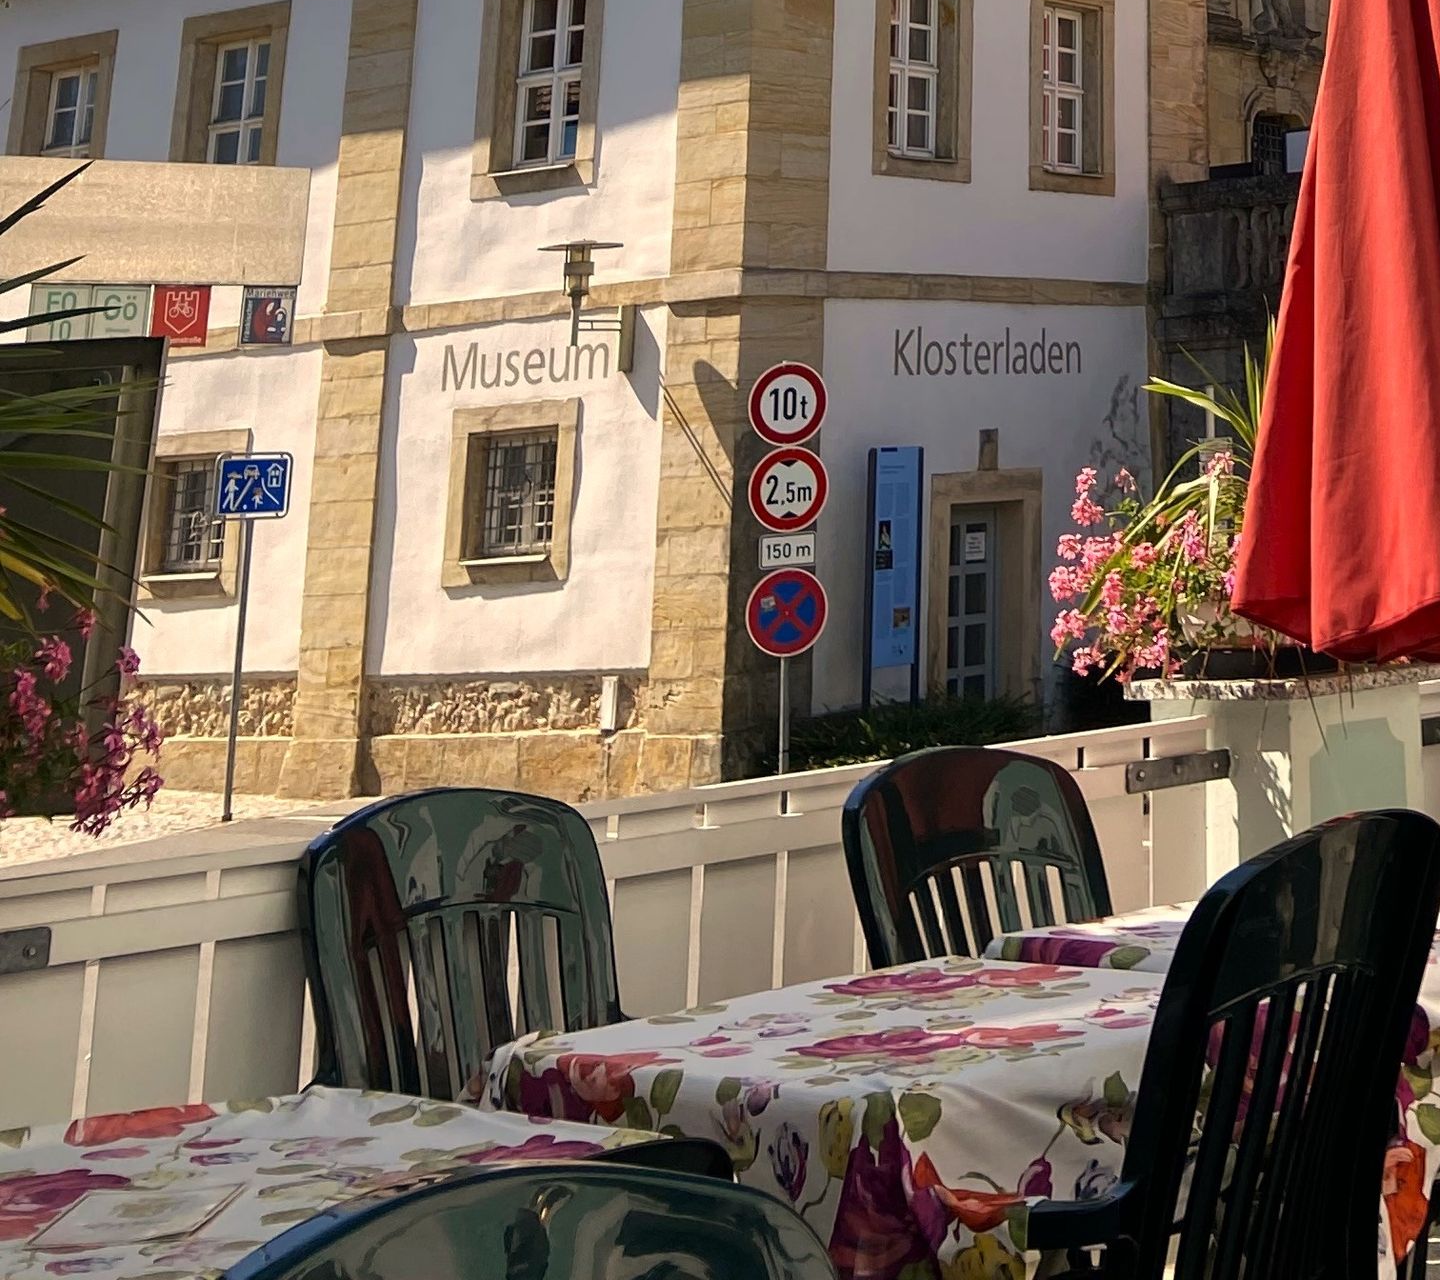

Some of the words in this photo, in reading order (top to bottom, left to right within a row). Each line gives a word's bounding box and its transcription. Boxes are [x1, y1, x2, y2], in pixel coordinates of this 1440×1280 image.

[441, 342, 610, 392] Museum
[893, 326, 1082, 376] Klosterladen
[766, 542, 792, 560] 150
[796, 543, 811, 558] m
